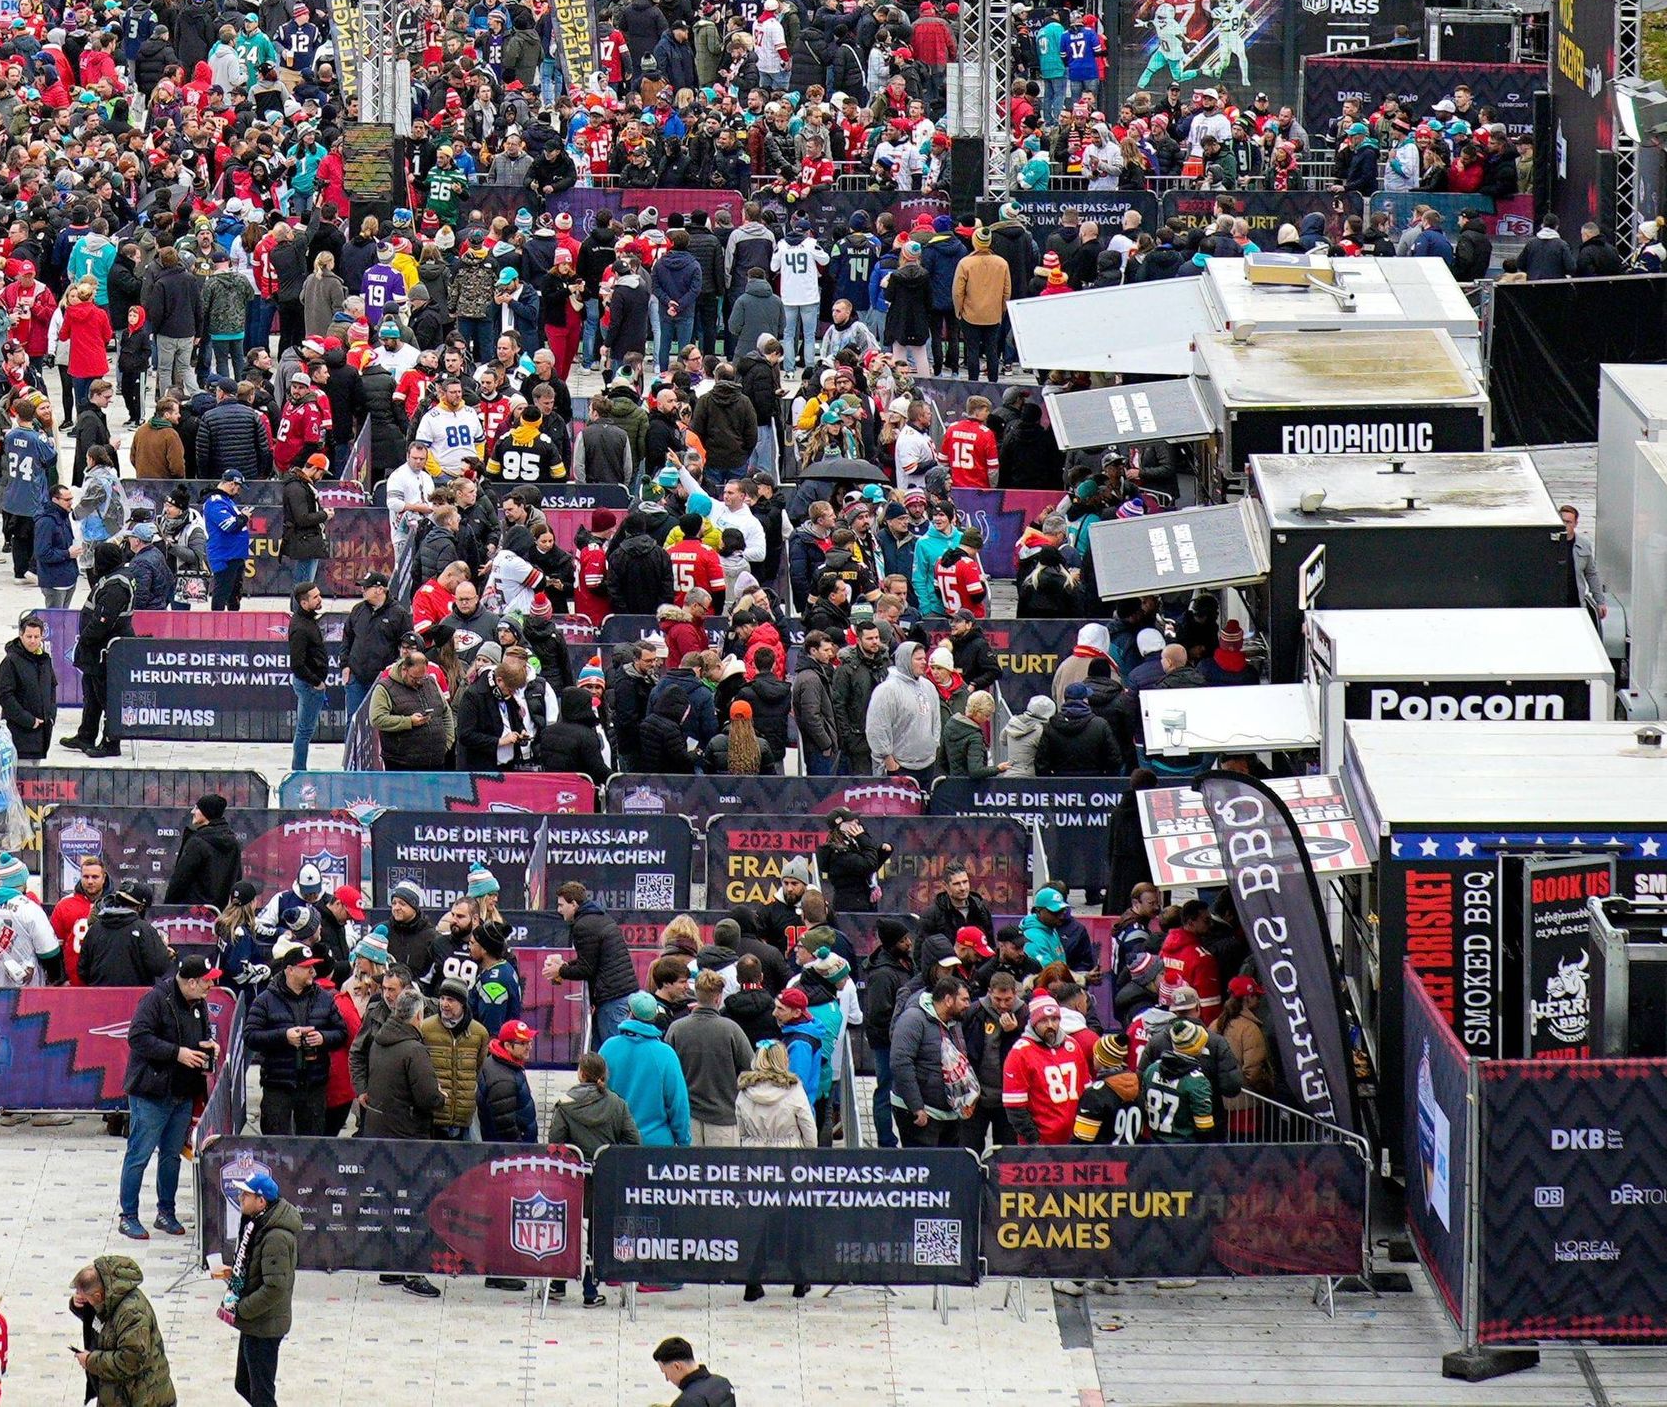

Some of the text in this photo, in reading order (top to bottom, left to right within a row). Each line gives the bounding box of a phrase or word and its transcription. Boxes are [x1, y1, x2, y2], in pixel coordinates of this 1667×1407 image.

[741, 2, 757, 21] 12
[1331, 0, 1380, 15] PASS
[129, 19, 137, 38] 3
[1444, 24, 1454, 37] A
[290, 35, 310, 54] 12
[1071, 41, 1085, 58] 17
[239, 45, 257, 64] 24
[802, 166, 817, 183] 87
[431, 182, 451, 201] 26
[1018, 202, 1035, 213] DIE
[1037, 202, 1056, 213] NFL
[1038, 216, 1056, 226] UM
[787, 255, 807, 274] 49
[849, 258, 869, 282] 14
[367, 285, 385, 306] 19
[447, 426, 471, 448] 88
[1282, 422, 1433, 453] FOODAHOLIC
[952, 442, 974, 469] 15
[7, 452, 33, 481] 24
[503, 451, 540, 481] 95
[673, 563, 695, 591] 15
[938, 577, 960, 612] 15
[147, 653, 185, 666] LADE
[190, 653, 215, 666] DIE
[219, 653, 249, 667] NFL
[130, 670, 216, 686] HERUNTER,
[222, 672, 246, 685] UM
[1370, 689, 1565, 721] Popcorn
[139, 708, 214, 726] ONE PASS
[974, 793, 1085, 807] LADE DIE NFL
[1055, 813, 1077, 826] UM
[414, 827, 529, 843] LADE DIE NFL
[738, 833, 785, 849] 2023
[62, 842, 98, 850] FRANKFURT
[397, 846, 525, 865] HERUNTER, UM
[1531, 871, 1611, 904] BOOK US
[1406, 870, 1454, 968] BRISKET
[1464, 871, 1494, 1044] SMOKED BBQ
[1044, 1063, 1079, 1103] 87
[1147, 1090, 1180, 1133] 87
[1114, 1106, 1141, 1145] 90
[1551, 1128, 1605, 1150] DKB
[338, 1164, 358, 1174] DKB
[648, 1164, 929, 1184] LADE DIE NFL ONEPASS-APP
[1011, 1165, 1113, 1183] 2023 NFL
[625, 1187, 950, 1208] HERUNTER, UM MITZUMACHEN!
[999, 1191, 1193, 1218] FRANKFURT
[516, 1222, 561, 1250] NFL
[997, 1223, 1111, 1249] GAMES
[636, 1237, 738, 1262] ONE PASS
[1580, 1252, 1620, 1261] EXPERT
